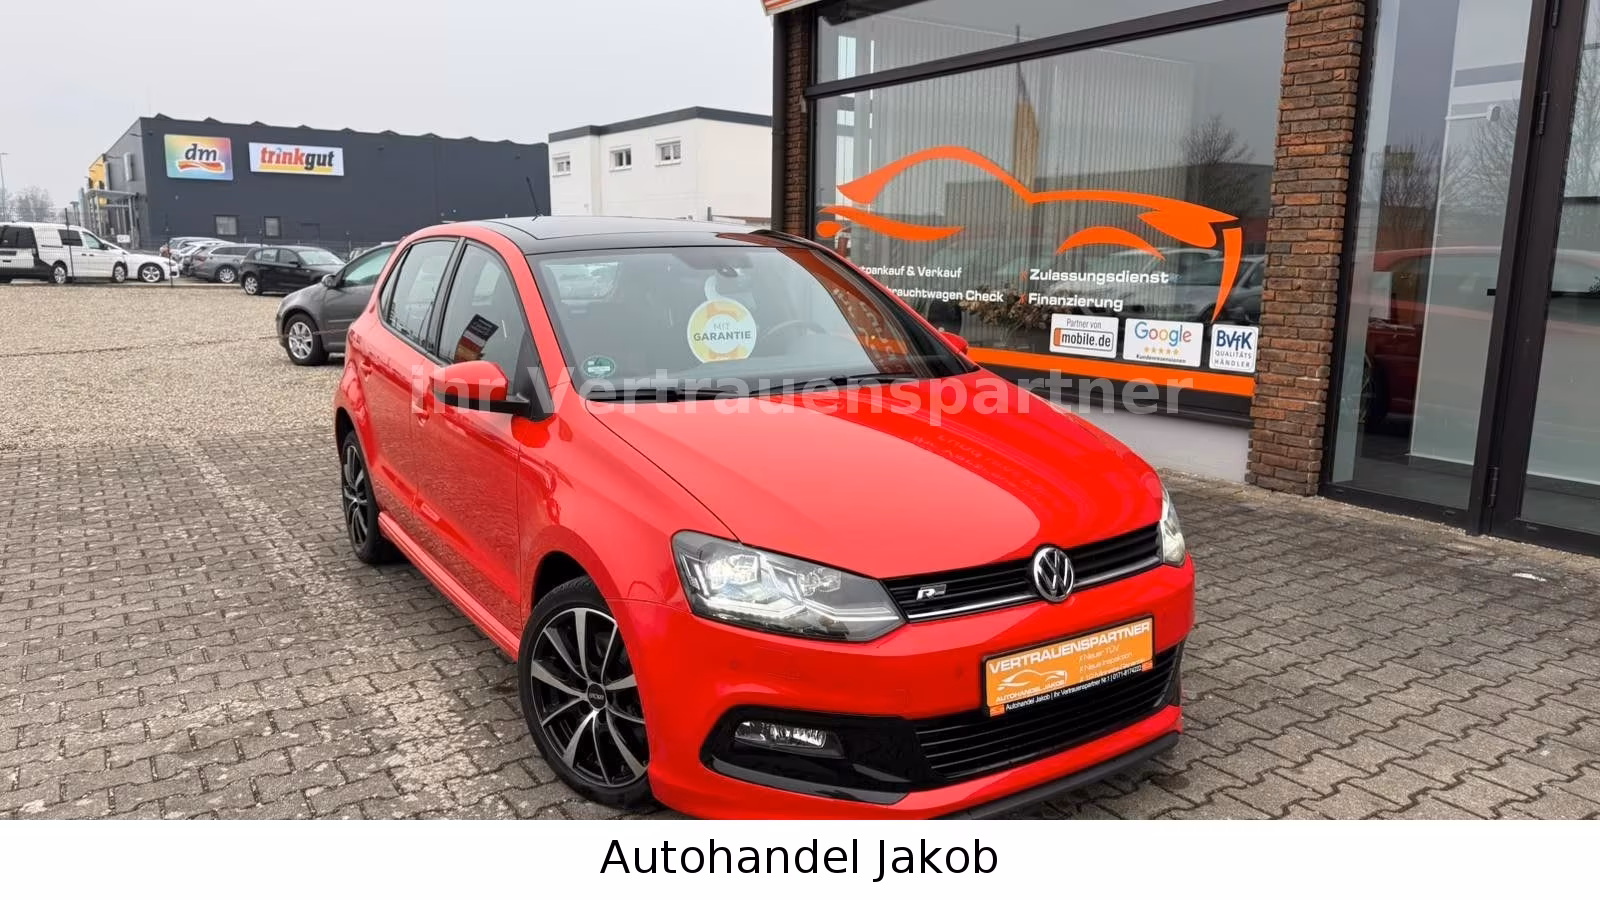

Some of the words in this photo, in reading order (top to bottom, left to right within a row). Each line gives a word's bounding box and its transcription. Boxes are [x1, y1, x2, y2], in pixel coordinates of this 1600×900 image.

[185, 143, 217, 162] dm
[260, 147, 335, 170] trinkgut
[906, 266, 915, 276] &
[917, 266, 962, 278] Verkauf
[1029, 268, 1169, 284] Zulassungsdienst
[965, 289, 1004, 302] Check
[1028, 293, 1124, 312] Finanzierung
[713, 322, 730, 330] MIT
[1066, 317, 1089, 328] Partner
[1090, 321, 1102, 329] von
[693, 330, 751, 341] GARANTIE
[1061, 332, 1111, 347] mobile.de
[1134, 321, 1192, 347] Google
[1214, 350, 1252, 359] QUALITÄTS
[1214, 359, 1250, 368] HÄNDLER
[989, 621, 1150, 674] VERTRAUENSPARTNER
[1006, 697, 1034, 710] Autohandel
